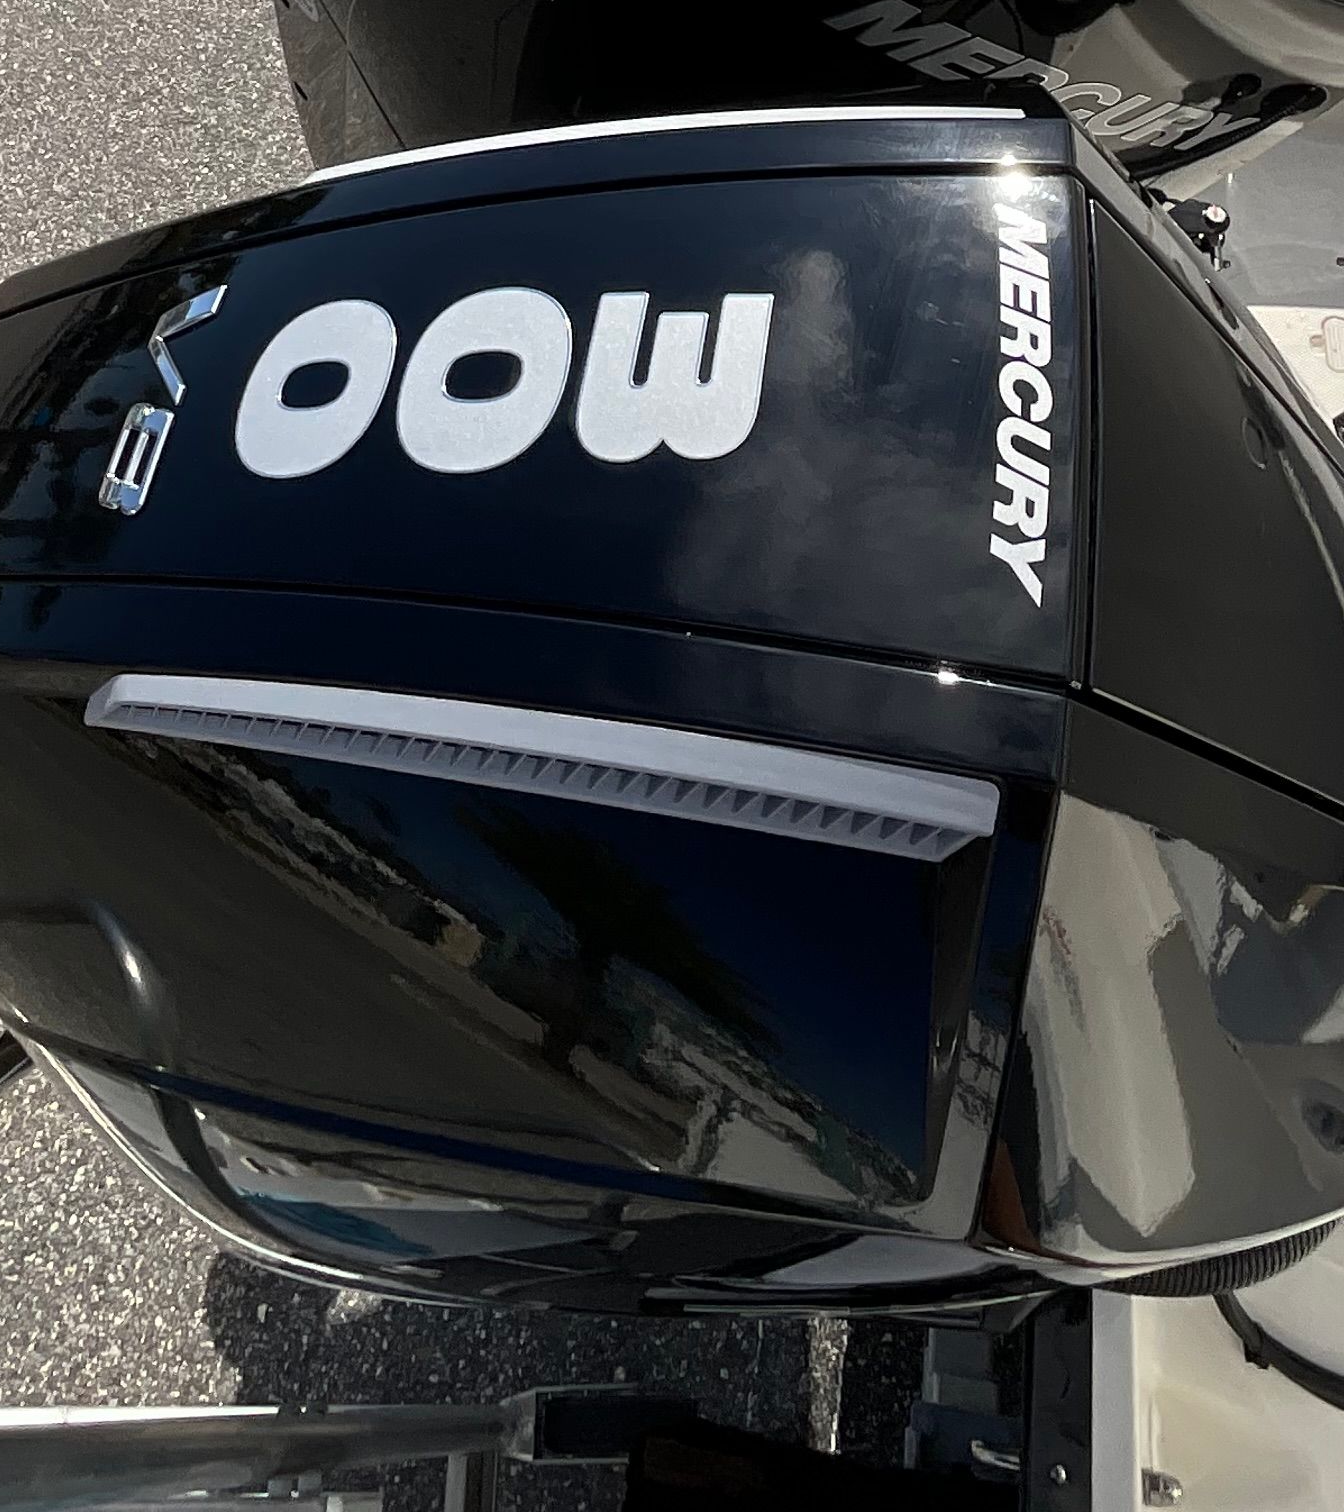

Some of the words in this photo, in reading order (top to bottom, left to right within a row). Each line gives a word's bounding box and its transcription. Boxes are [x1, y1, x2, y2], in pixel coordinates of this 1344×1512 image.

[98, 284, 228, 515] V8
[235, 286, 775, 479] 300
[990, 202, 1054, 608] MERCURY
